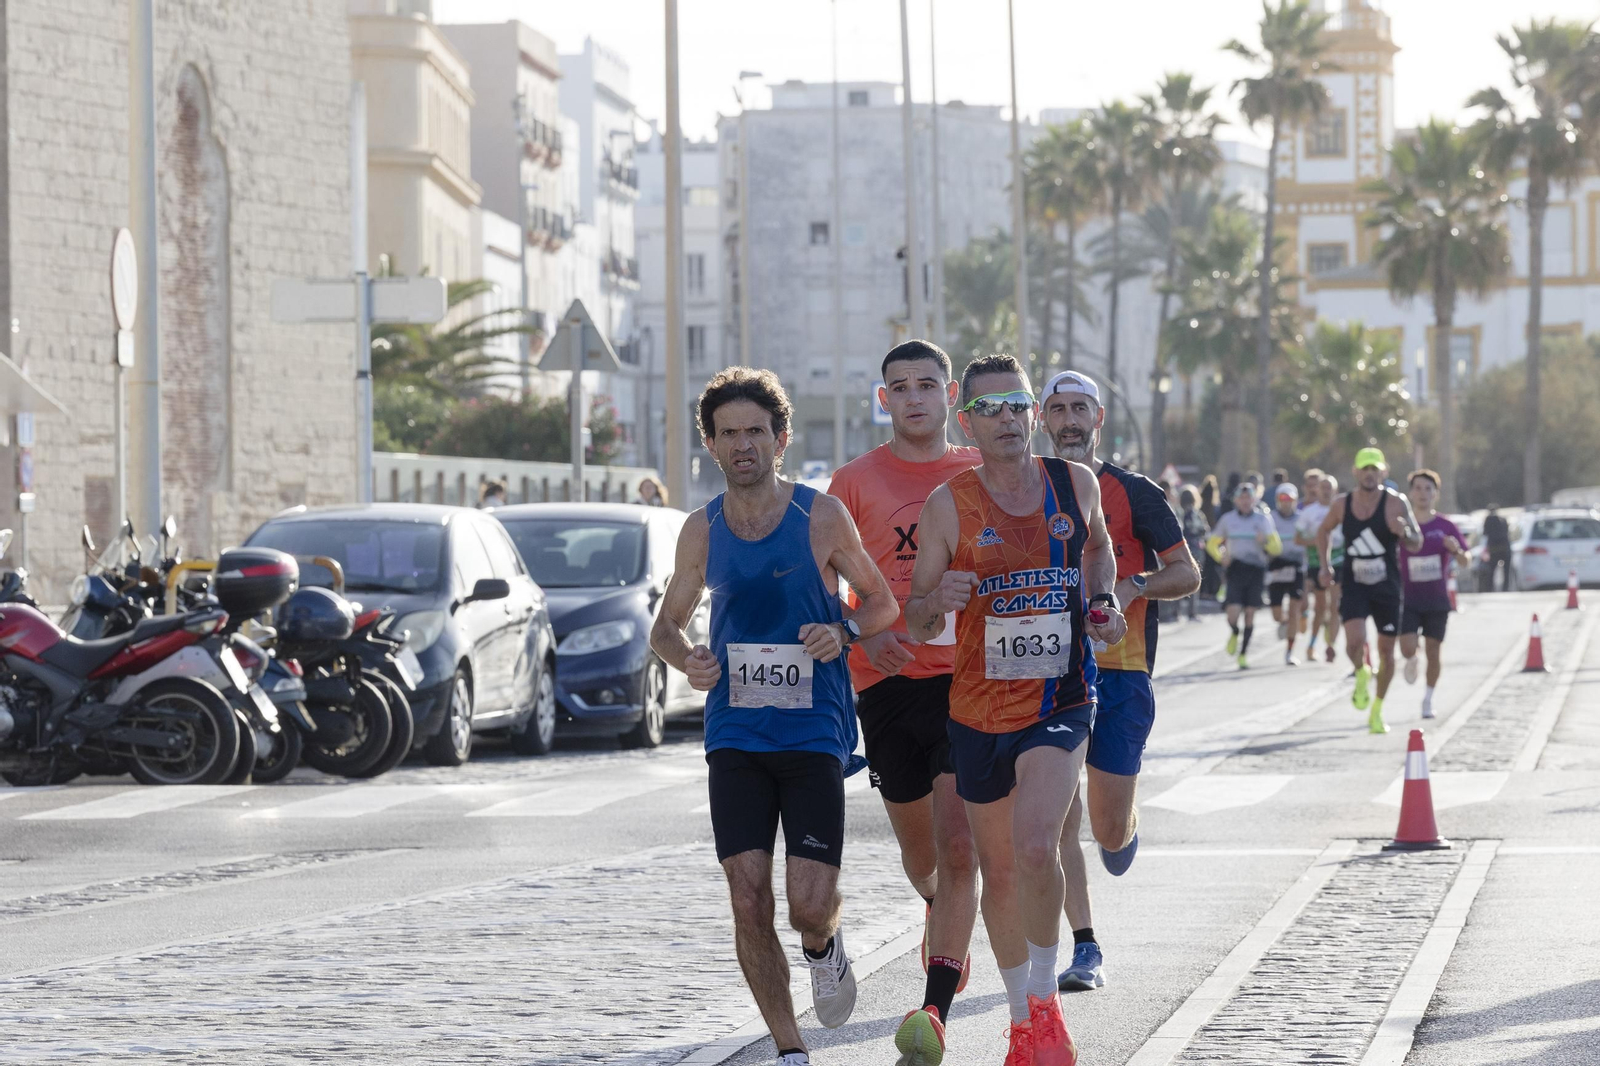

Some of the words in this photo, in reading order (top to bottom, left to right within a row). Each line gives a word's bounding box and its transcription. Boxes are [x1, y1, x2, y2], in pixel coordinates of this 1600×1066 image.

[977, 567, 1079, 597] ATLETISMO
[992, 591, 1068, 614] CAMAS
[996, 633, 1061, 658] 1633
[738, 663, 800, 687] 1450
